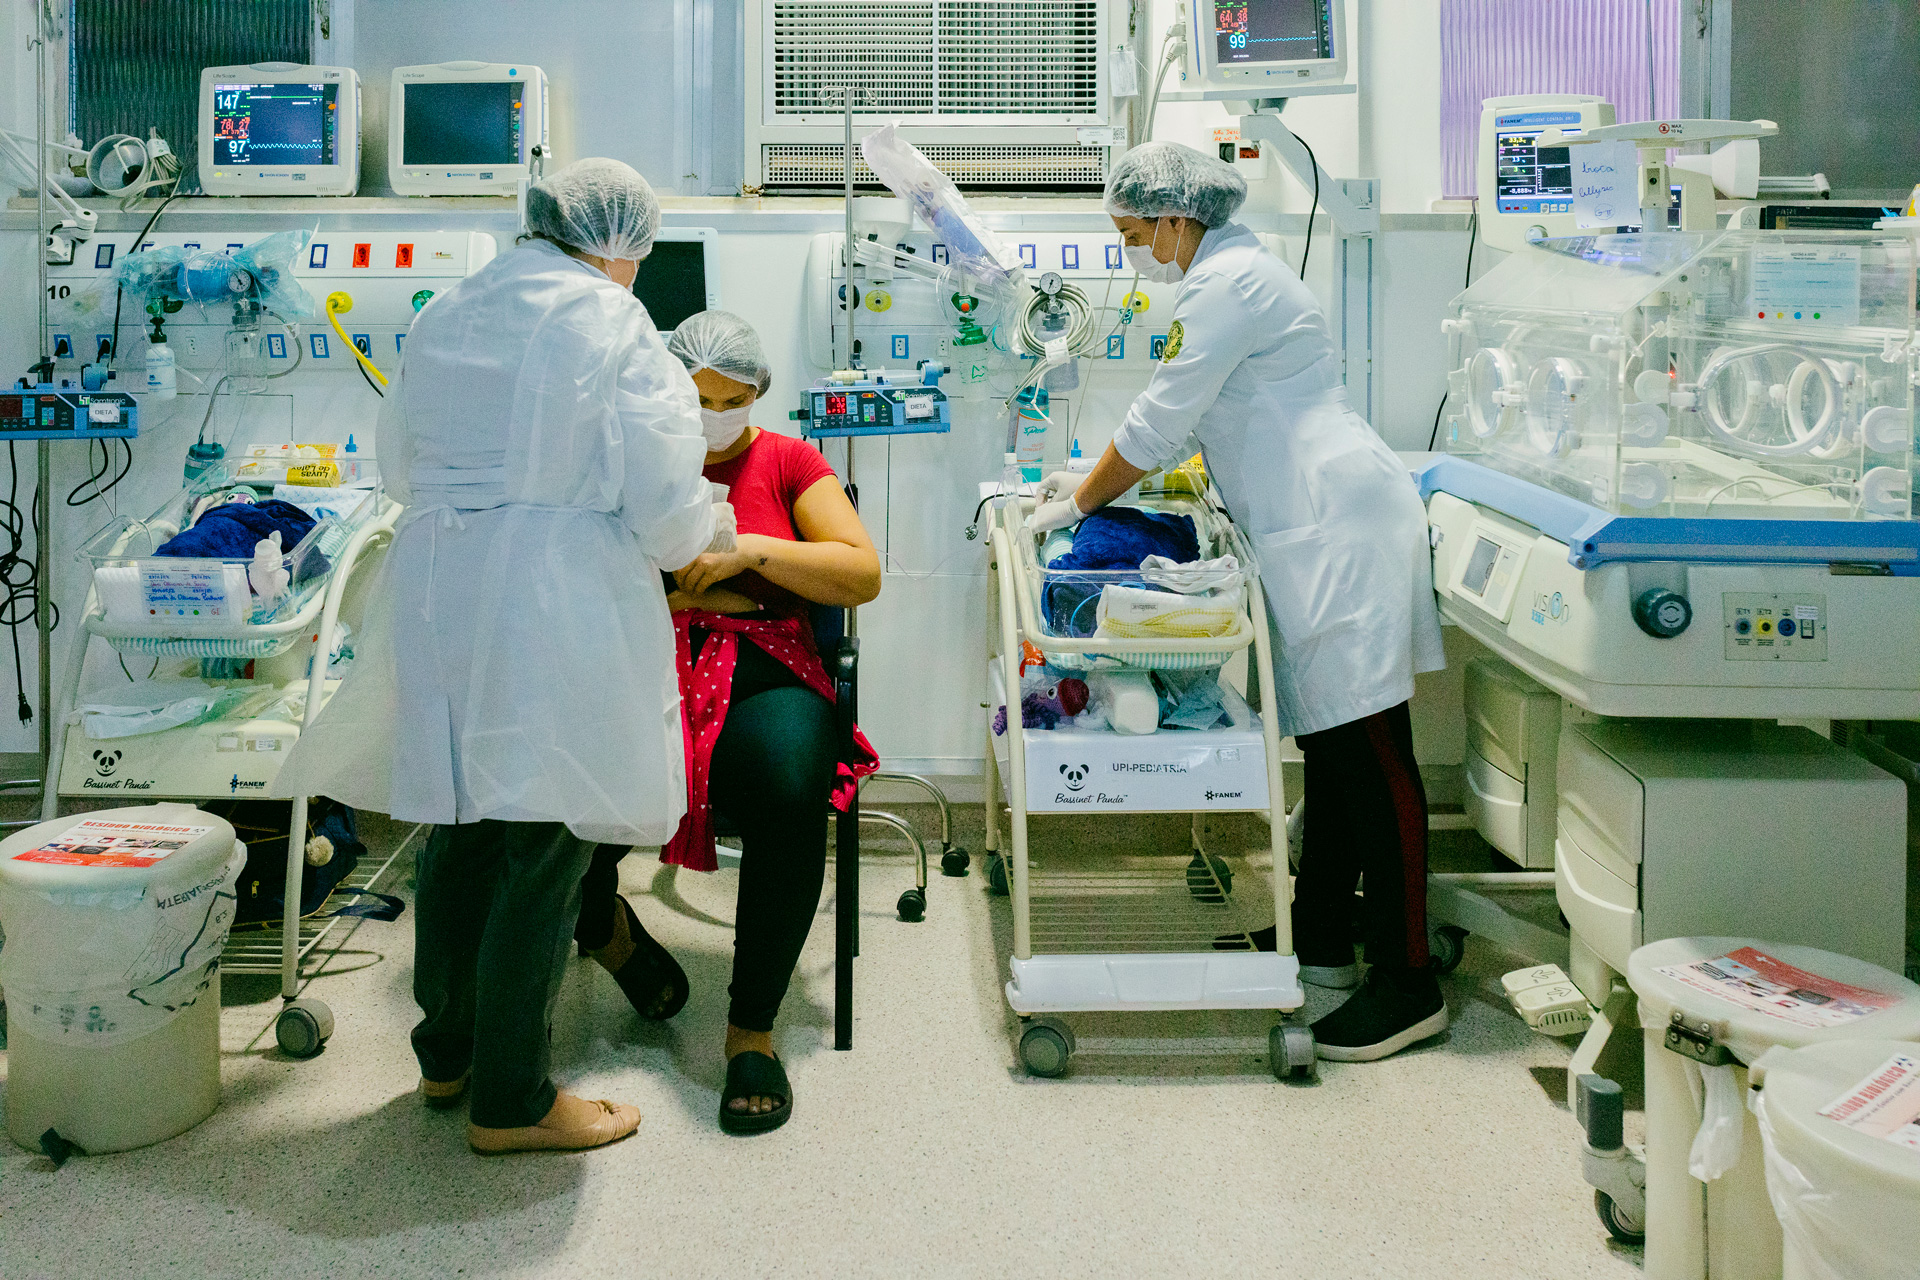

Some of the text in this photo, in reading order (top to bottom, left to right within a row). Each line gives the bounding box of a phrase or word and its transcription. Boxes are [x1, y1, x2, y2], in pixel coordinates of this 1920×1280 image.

[1229, 34, 1246, 49] 99
[217, 94, 239, 110] 147
[229, 140, 247, 153] 97
[47, 285, 71, 299] 10
[838, 284, 860, 311] 9
[300, 471, 329, 479] Luvas
[1112, 763, 1187, 773] UPI-PEDIATRIA
[83, 778, 122, 788] Bassinet
[1055, 793, 1094, 804] Bassinet
[1858, 1066, 1907, 1100] BIOLÓGICO
